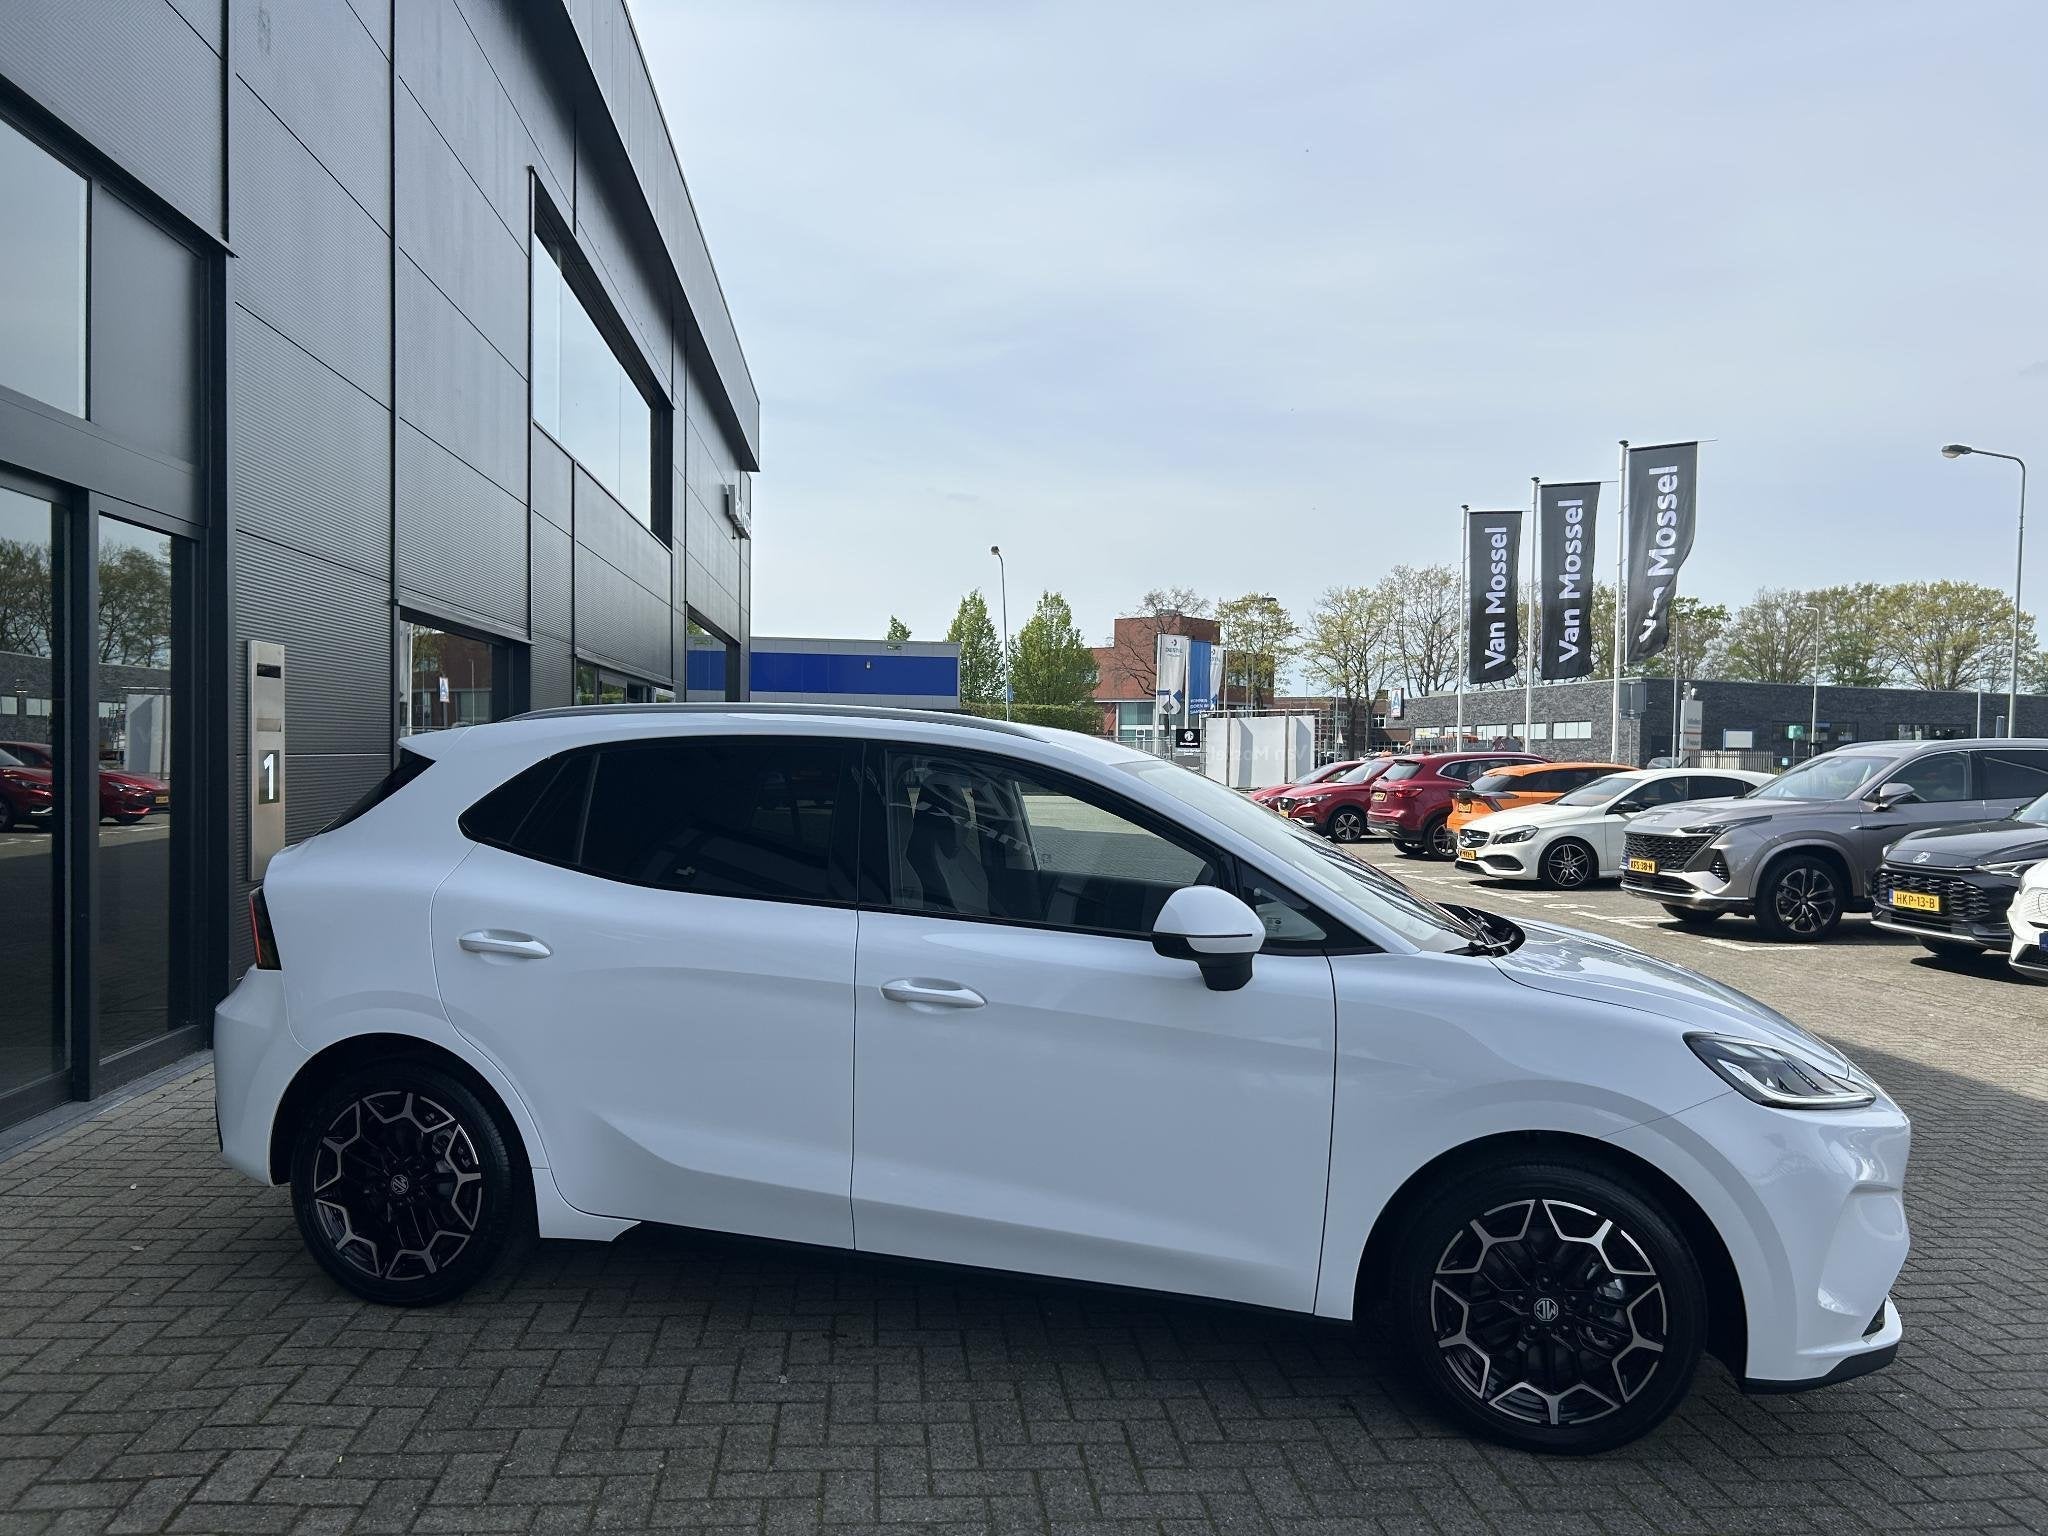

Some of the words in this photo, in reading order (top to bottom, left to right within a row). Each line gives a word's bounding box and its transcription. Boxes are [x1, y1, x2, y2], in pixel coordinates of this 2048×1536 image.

[1647, 465, 1678, 577] Mossel
[1484, 527, 1508, 614] Mossel
[1558, 499, 1584, 600] Mossel
[1484, 621, 1507, 669] Van
[1558, 608, 1580, 663] Van
[263, 753, 274, 800] 1
[1896, 893, 1935, 908] HKP-13-B
[1535, 1299, 1558, 1320] MG
